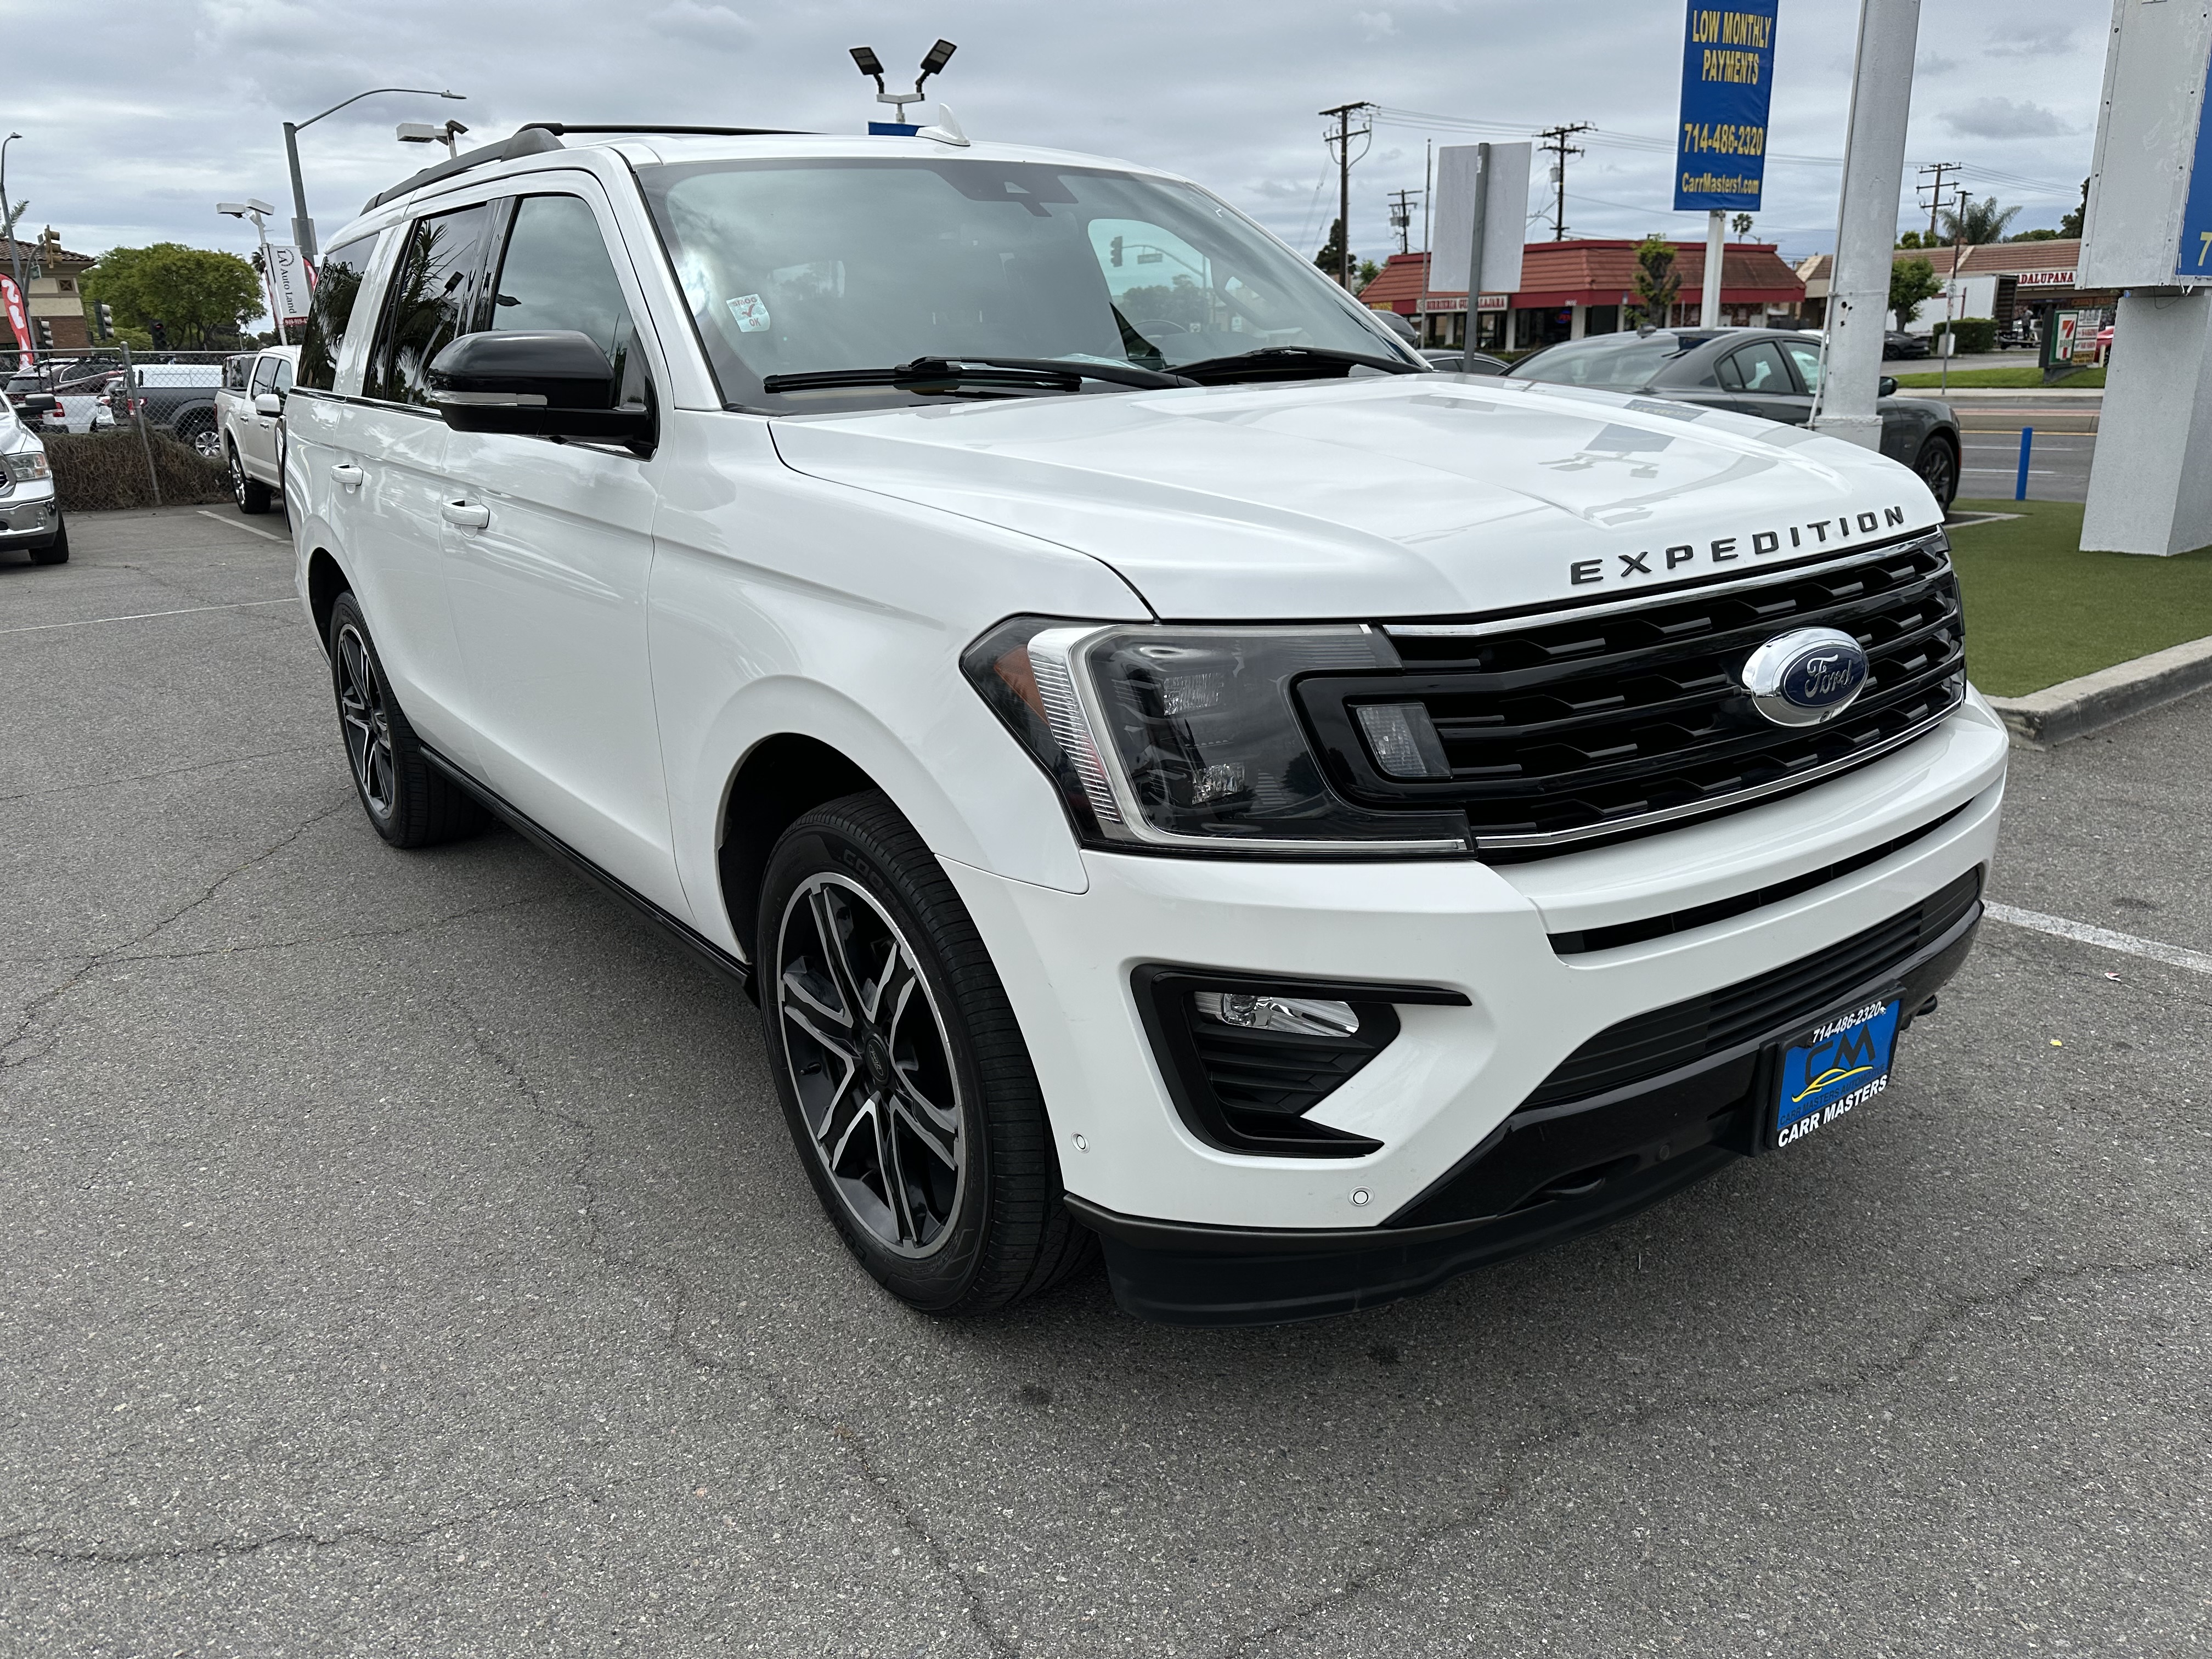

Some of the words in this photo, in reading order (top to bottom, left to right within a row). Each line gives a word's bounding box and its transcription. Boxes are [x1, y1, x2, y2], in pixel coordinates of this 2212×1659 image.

[1692, 10, 1720, 43] LOW
[1722, 11, 1771, 48] MONTHLY
[1702, 49, 1760, 85] PAYMENTS
[1684, 123, 1764, 156] 714-486-2320
[1681, 172, 1759, 195] CarrMasters1.com
[276, 250, 289, 264] LA
[280, 268, 290, 290] Auto
[285, 292, 297, 314] Land
[2017, 272, 2073, 284] DALUPANA
[731, 297, 758, 307] SMOG
[749, 317, 761, 327] OK
[1570, 506, 1905, 585] EXPEDITION
[1804, 653, 1854, 699] Ford
[1812, 1001, 1882, 1043] 714-486-2320
[1804, 1023, 1876, 1086] CM
[1778, 1112, 1820, 1148] CARR
[1822, 1074, 1889, 1125] MASTERS
[1780, 1108, 1801, 1126] CARR
[1802, 1086, 1840, 1113] MASTERS
[1841, 1063, 1886, 1095] AUTOMOTIVE
